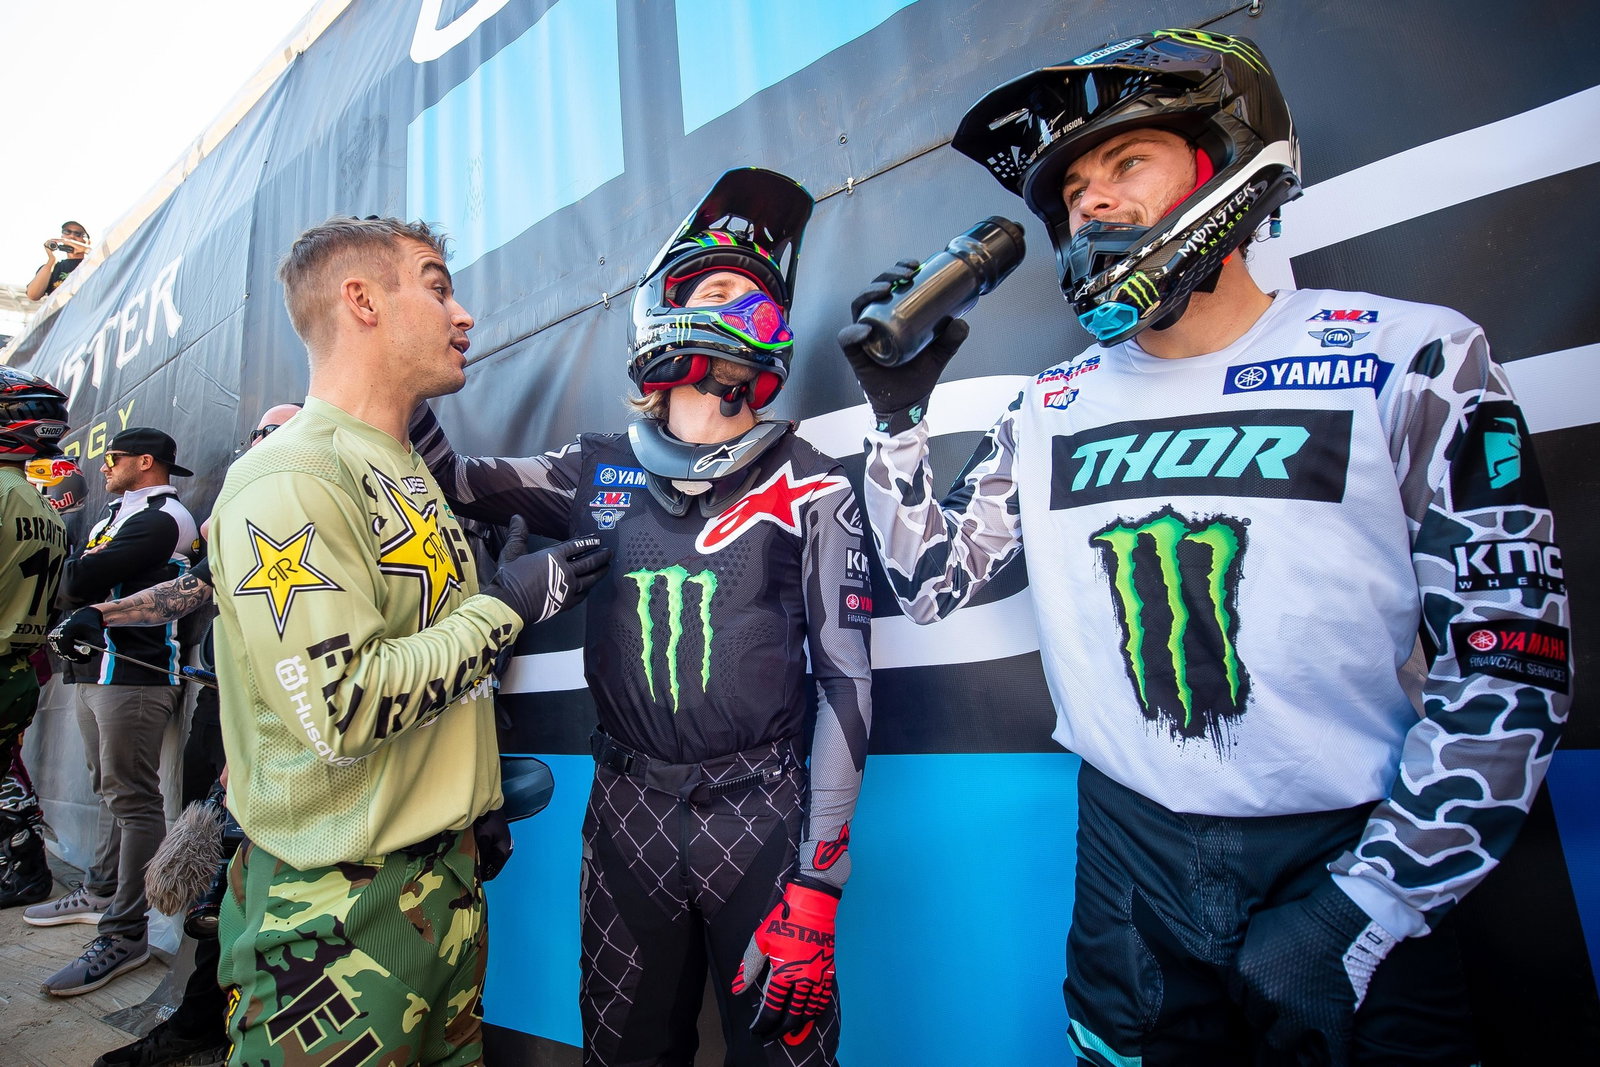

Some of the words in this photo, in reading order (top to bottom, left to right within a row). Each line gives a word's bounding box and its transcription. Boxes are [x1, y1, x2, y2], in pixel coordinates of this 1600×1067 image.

[1178, 182, 1255, 257] MONSTER
[1200, 204, 1249, 255] ENERGY
[1305, 308, 1379, 323] AMA
[1328, 333, 1348, 342] FIM
[1271, 359, 1377, 387] YAMAH
[1070, 425, 1311, 492] THOR
[618, 470, 646, 486] YAM
[589, 491, 632, 507] AMA
[15, 516, 67, 552] BRAYT
[1454, 541, 1564, 580] KMC
[1458, 576, 1566, 593] WHEELS
[13, 623, 47, 636] HON
[1500, 631, 1567, 661] YAMAHA
[1469, 655, 1523, 673] FINANCIAL
[765, 919, 835, 948] ASTARS
